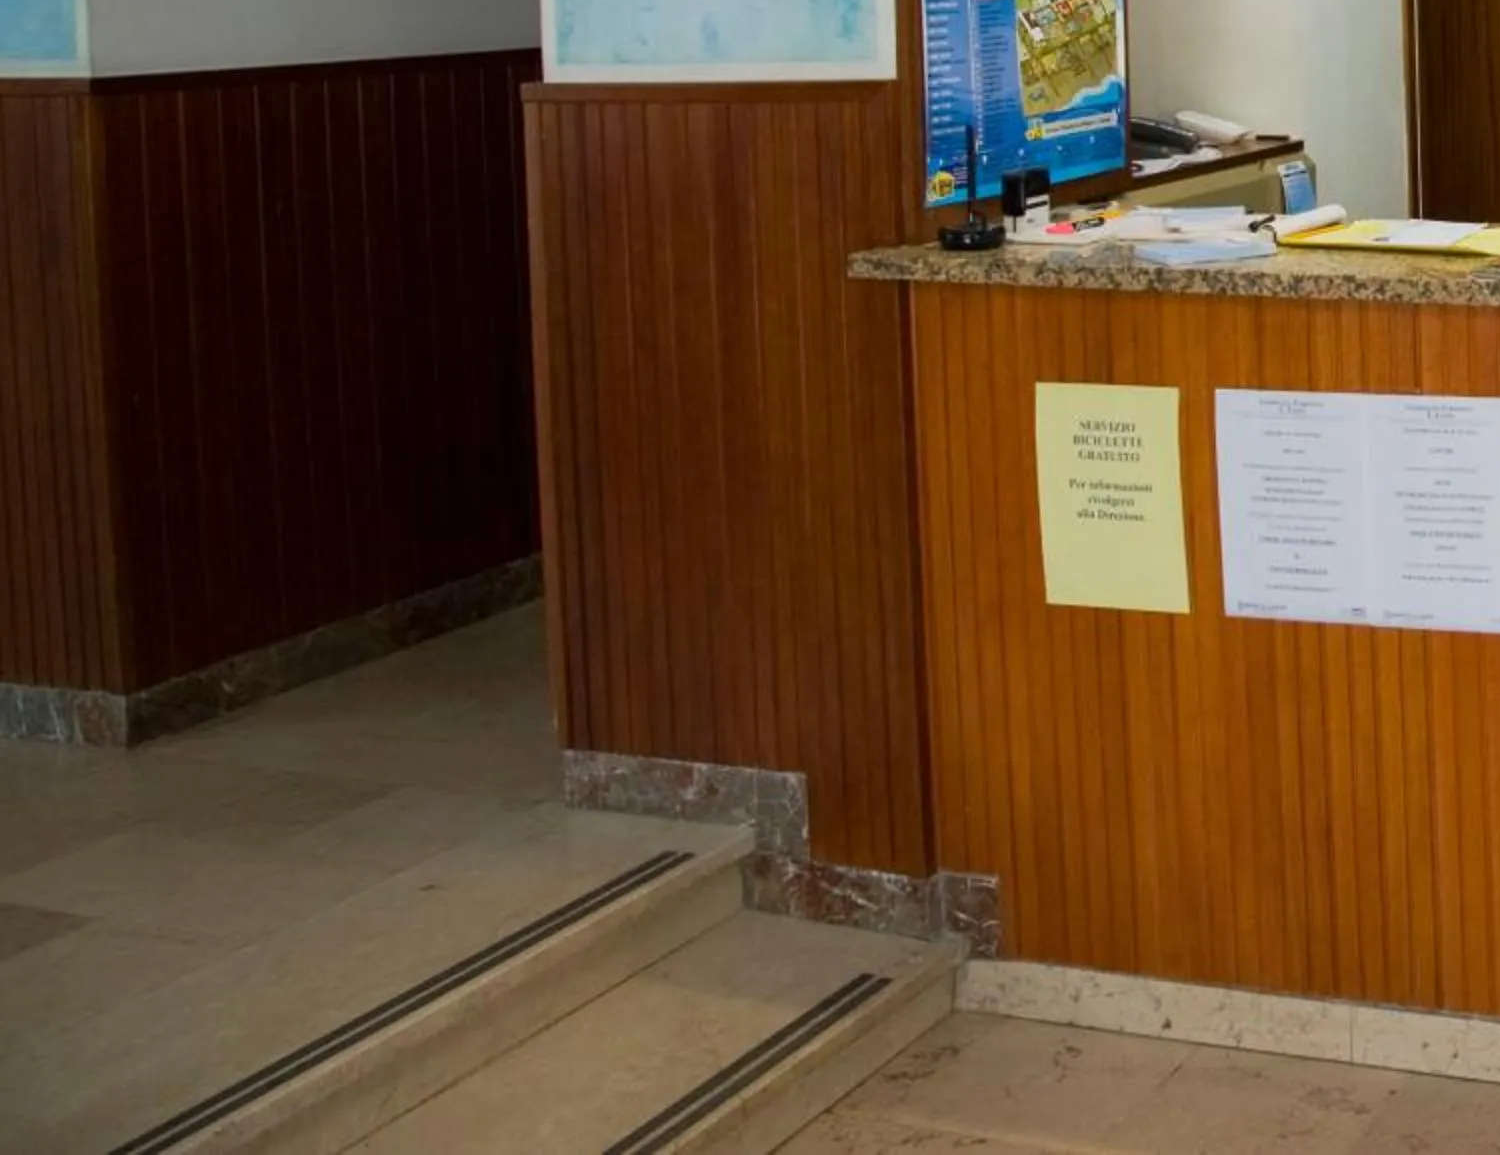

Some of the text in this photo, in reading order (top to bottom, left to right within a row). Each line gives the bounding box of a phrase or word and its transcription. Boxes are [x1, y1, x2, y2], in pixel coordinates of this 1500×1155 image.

[1079, 420, 1137, 434] SERVIZIO
[1073, 434, 1144, 449] BICICLETTE
[1078, 449, 1141, 463] GRATUITO
[1069, 478, 1086, 490] Per
